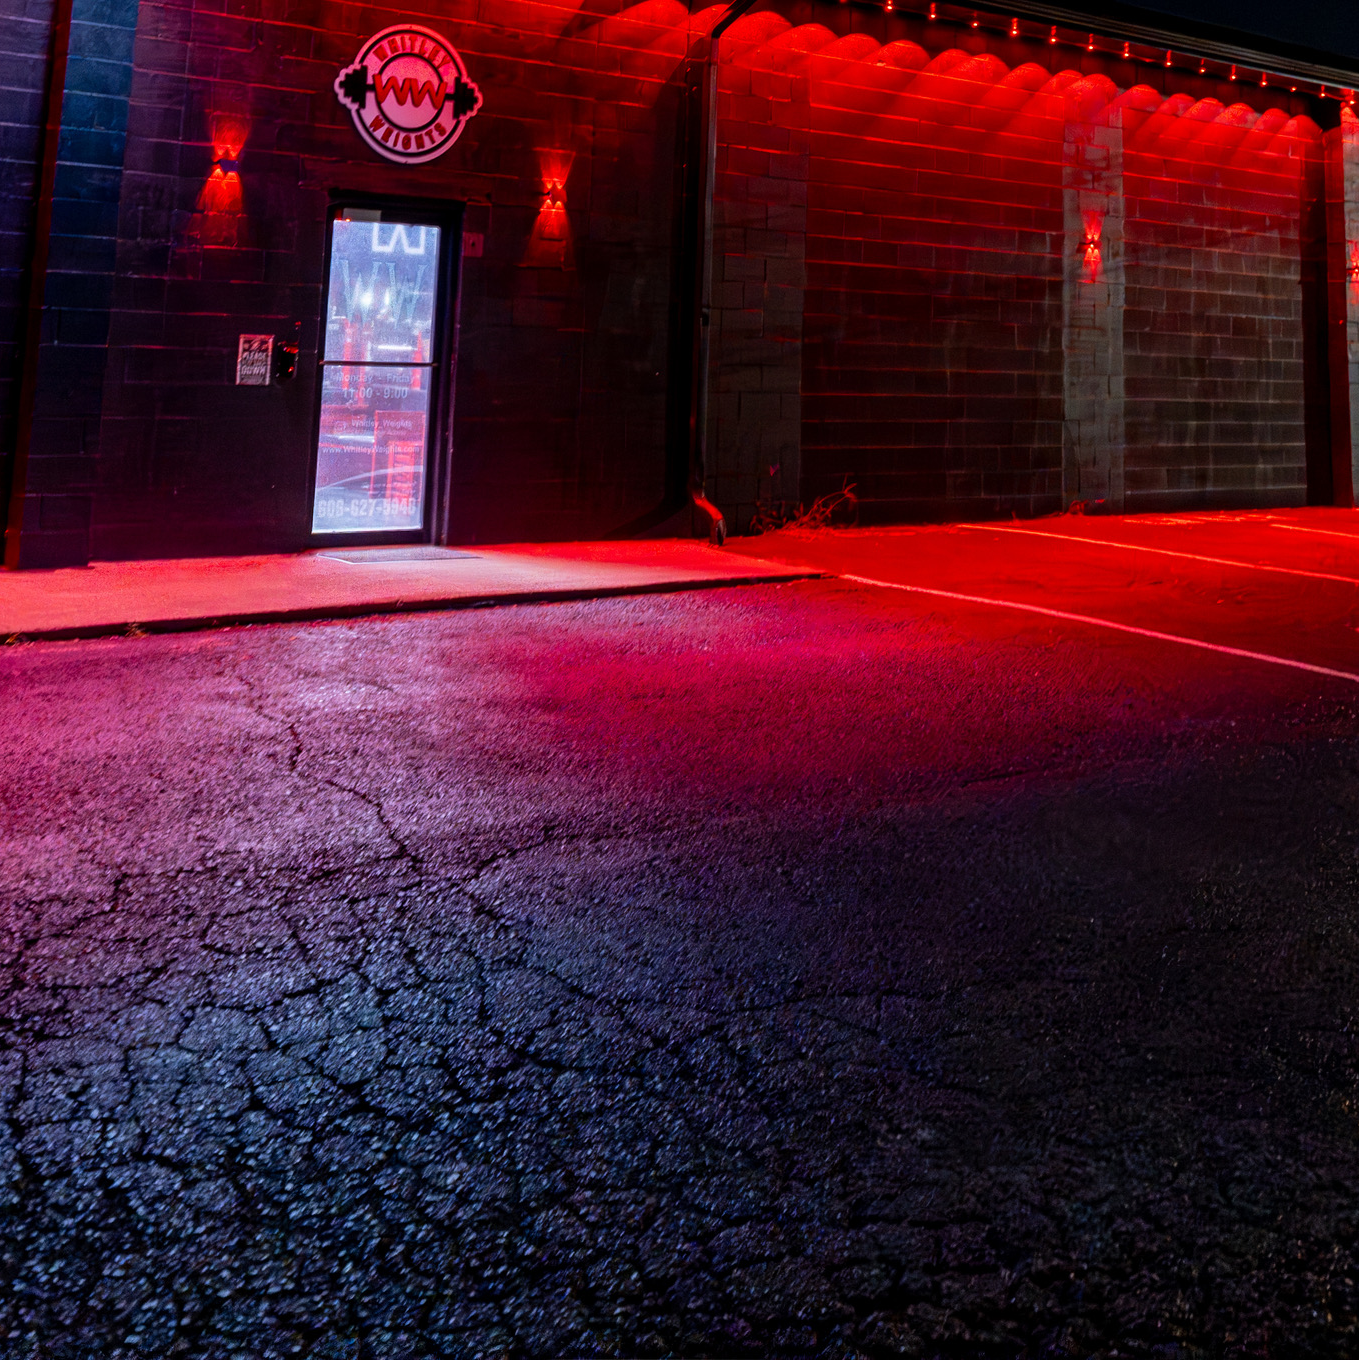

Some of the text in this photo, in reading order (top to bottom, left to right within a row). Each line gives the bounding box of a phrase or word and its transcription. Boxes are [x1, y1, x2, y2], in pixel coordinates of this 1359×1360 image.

[372, 35, 453, 71] WHITLEY
[373, 73, 448, 110] WW
[368, 114, 448, 151] WEIGHTS
[339, 258, 427, 330] WW
[335, 372, 373, 383] Monday
[386, 373, 415, 385] Friday
[383, 387, 409, 399] 9:00
